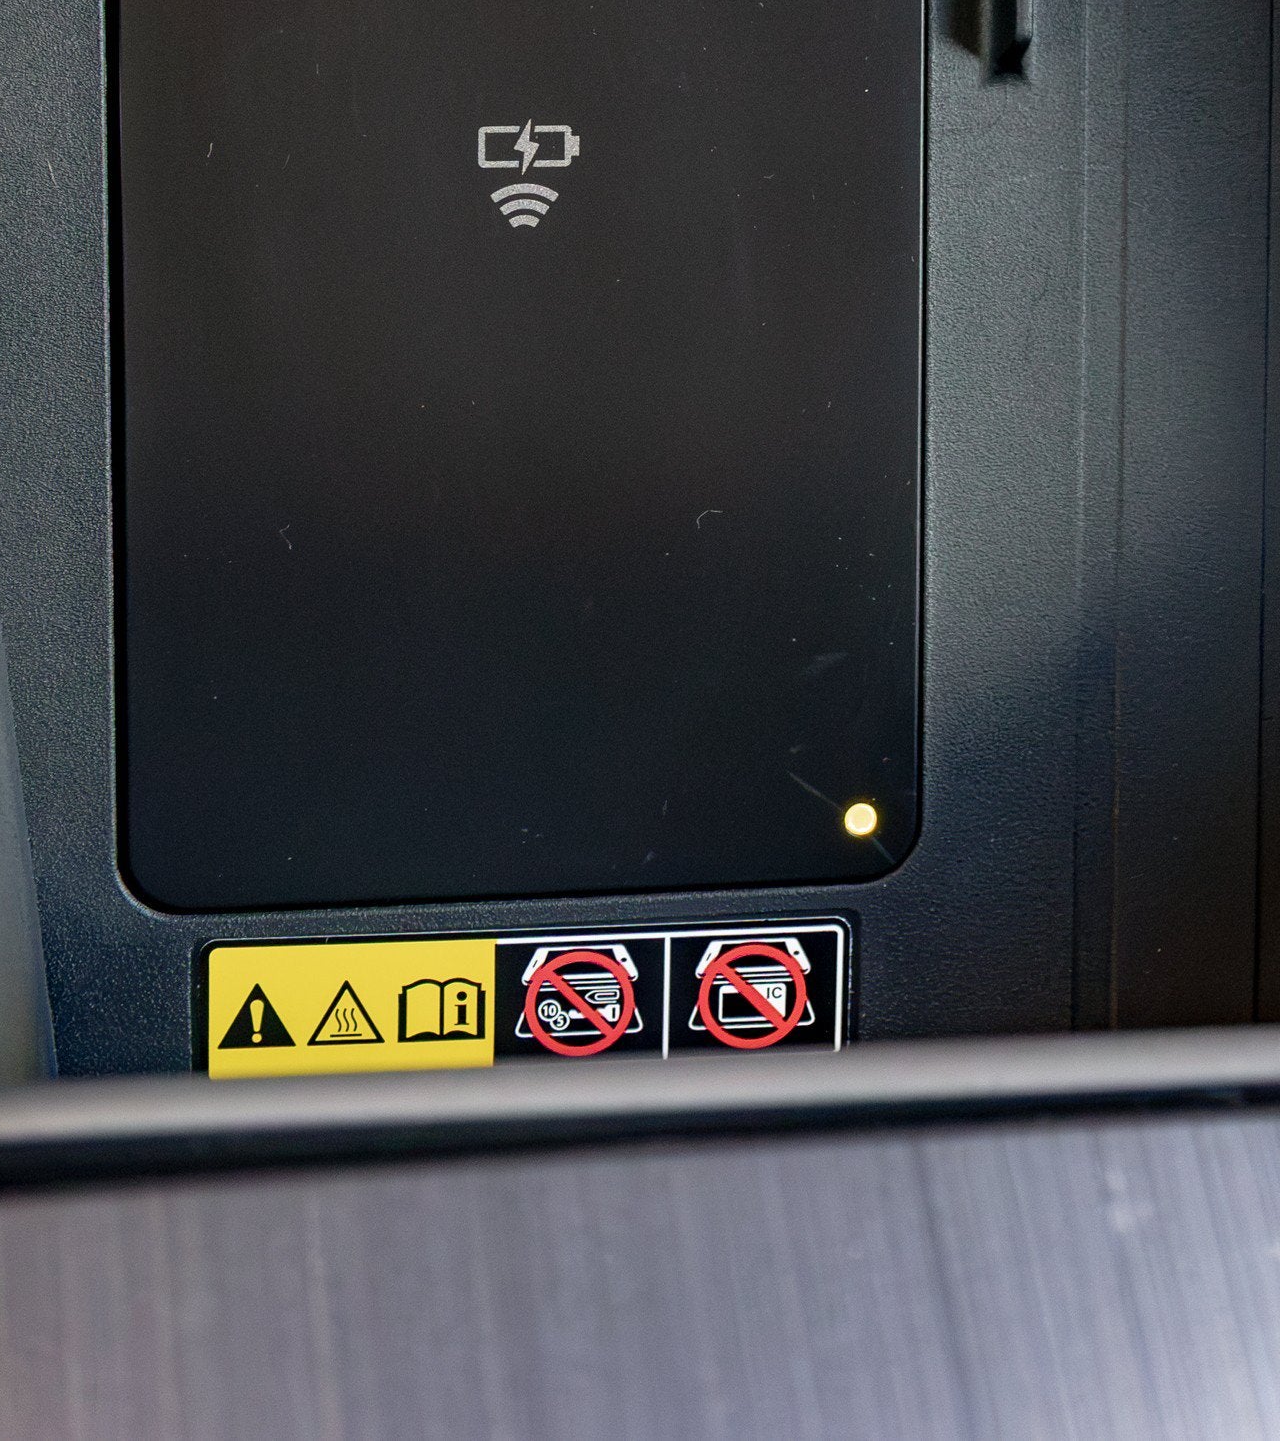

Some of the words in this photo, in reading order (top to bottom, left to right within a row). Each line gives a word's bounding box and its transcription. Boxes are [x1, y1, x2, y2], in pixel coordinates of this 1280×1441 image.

[766, 986, 783, 999] IC
[542, 1004, 557, 1017] 10
[555, 1015, 564, 1027] 5
